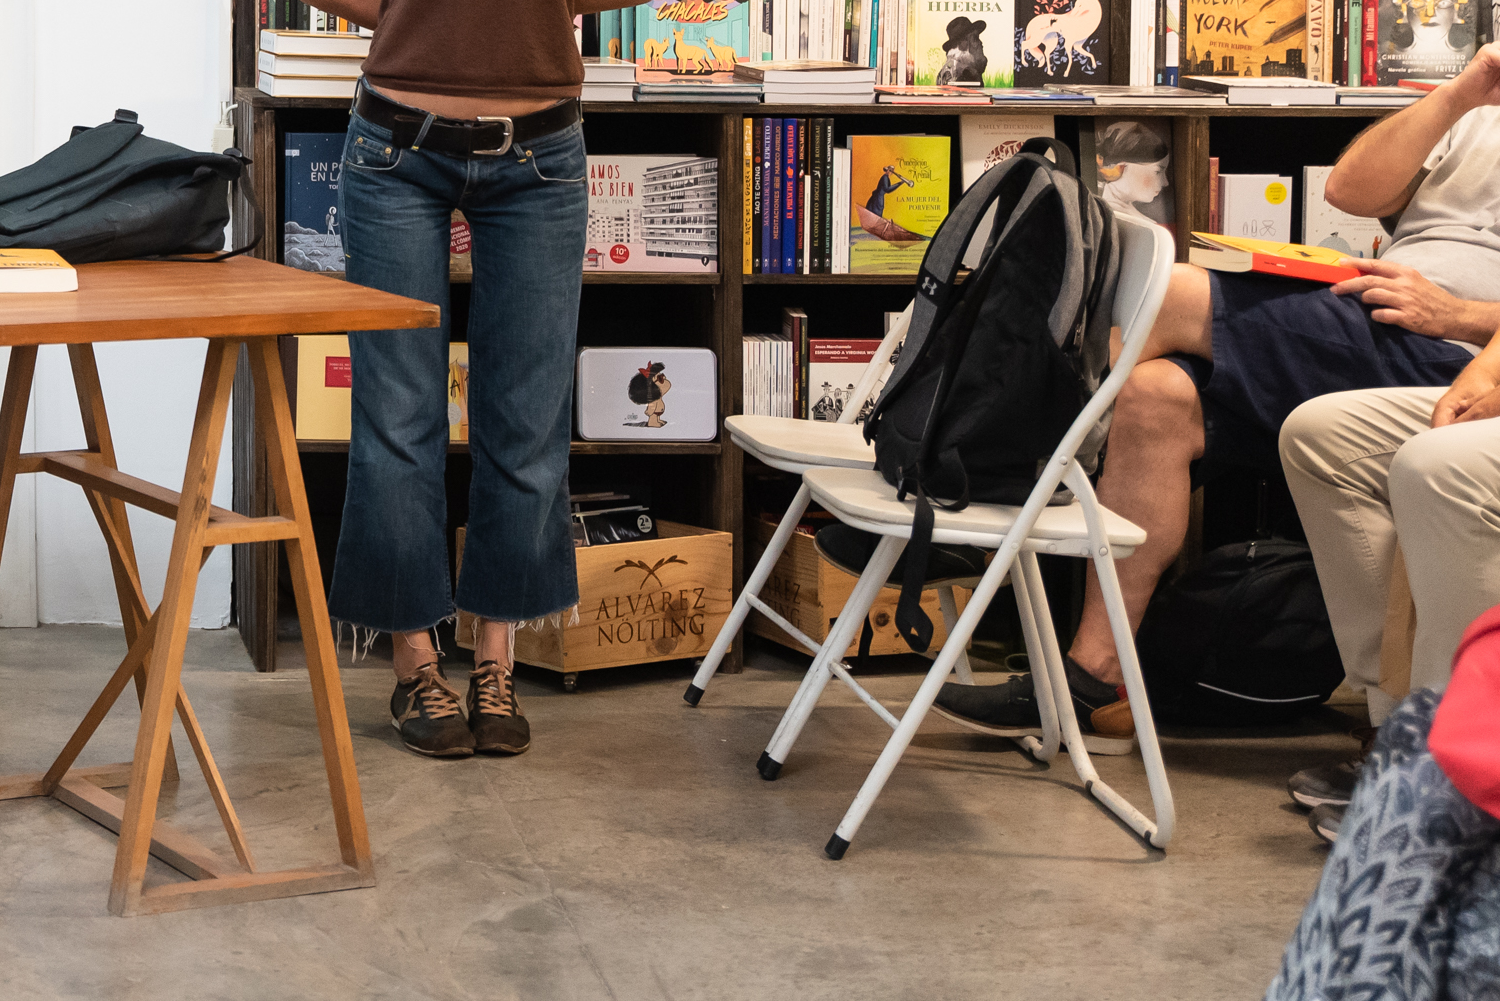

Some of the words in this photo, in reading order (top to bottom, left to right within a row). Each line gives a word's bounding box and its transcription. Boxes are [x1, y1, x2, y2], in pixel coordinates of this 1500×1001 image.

[656, 2, 728, 24] CHACALES
[928, 1, 1002, 12] HIERBA
[311, 163, 330, 171] UN
[591, 165, 620, 179] AMOS
[596, 587, 706, 621] ALVAREZ
[597, 613, 705, 647] NÖLTING
